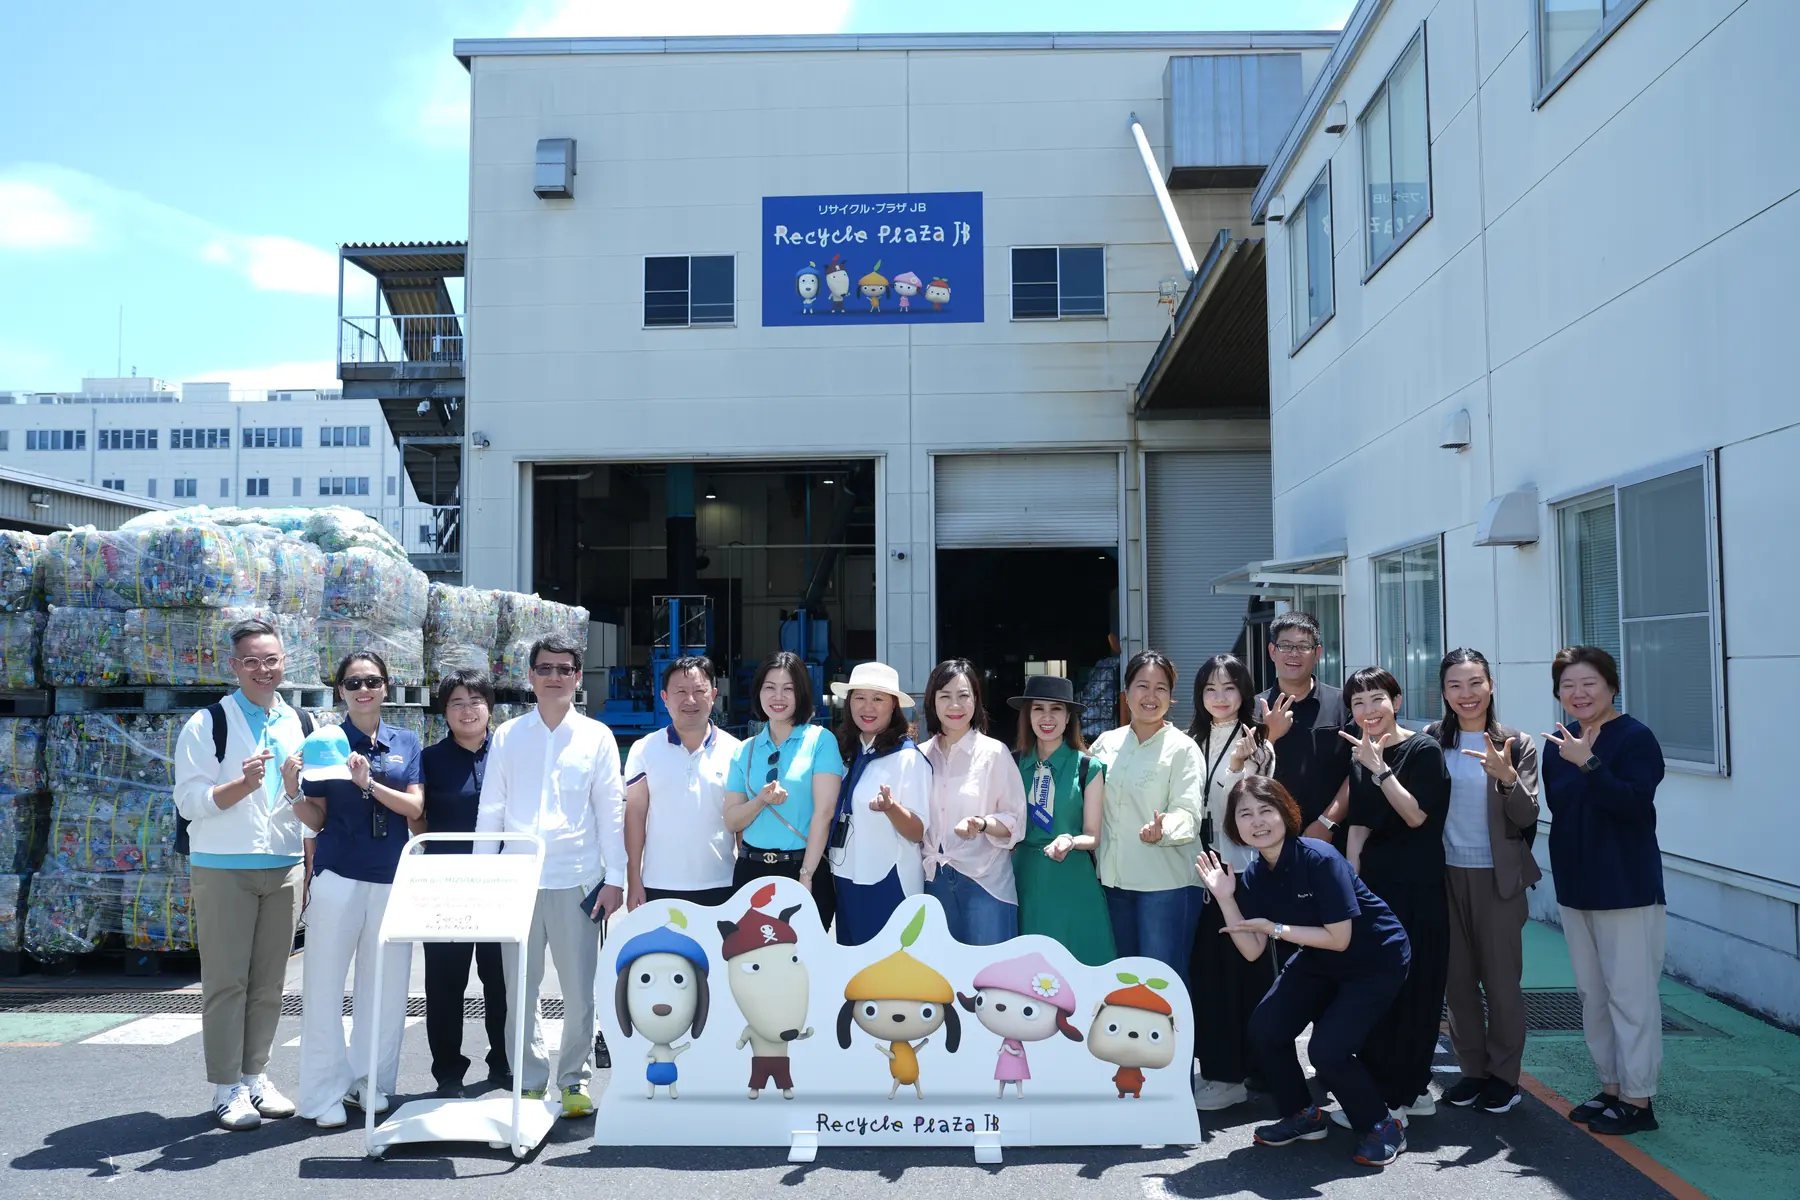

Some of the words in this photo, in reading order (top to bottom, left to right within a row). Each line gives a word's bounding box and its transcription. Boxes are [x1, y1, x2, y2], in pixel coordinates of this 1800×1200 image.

[818, 202, 907, 215] リサイクル・プラザ
[909, 202, 927, 213] JB
[774, 224, 868, 248] Recycle
[877, 224, 945, 244] Plaza
[952, 221, 971, 247] JB
[816, 1113, 904, 1136] Recycle
[913, 1115, 975, 1134] Plaza
